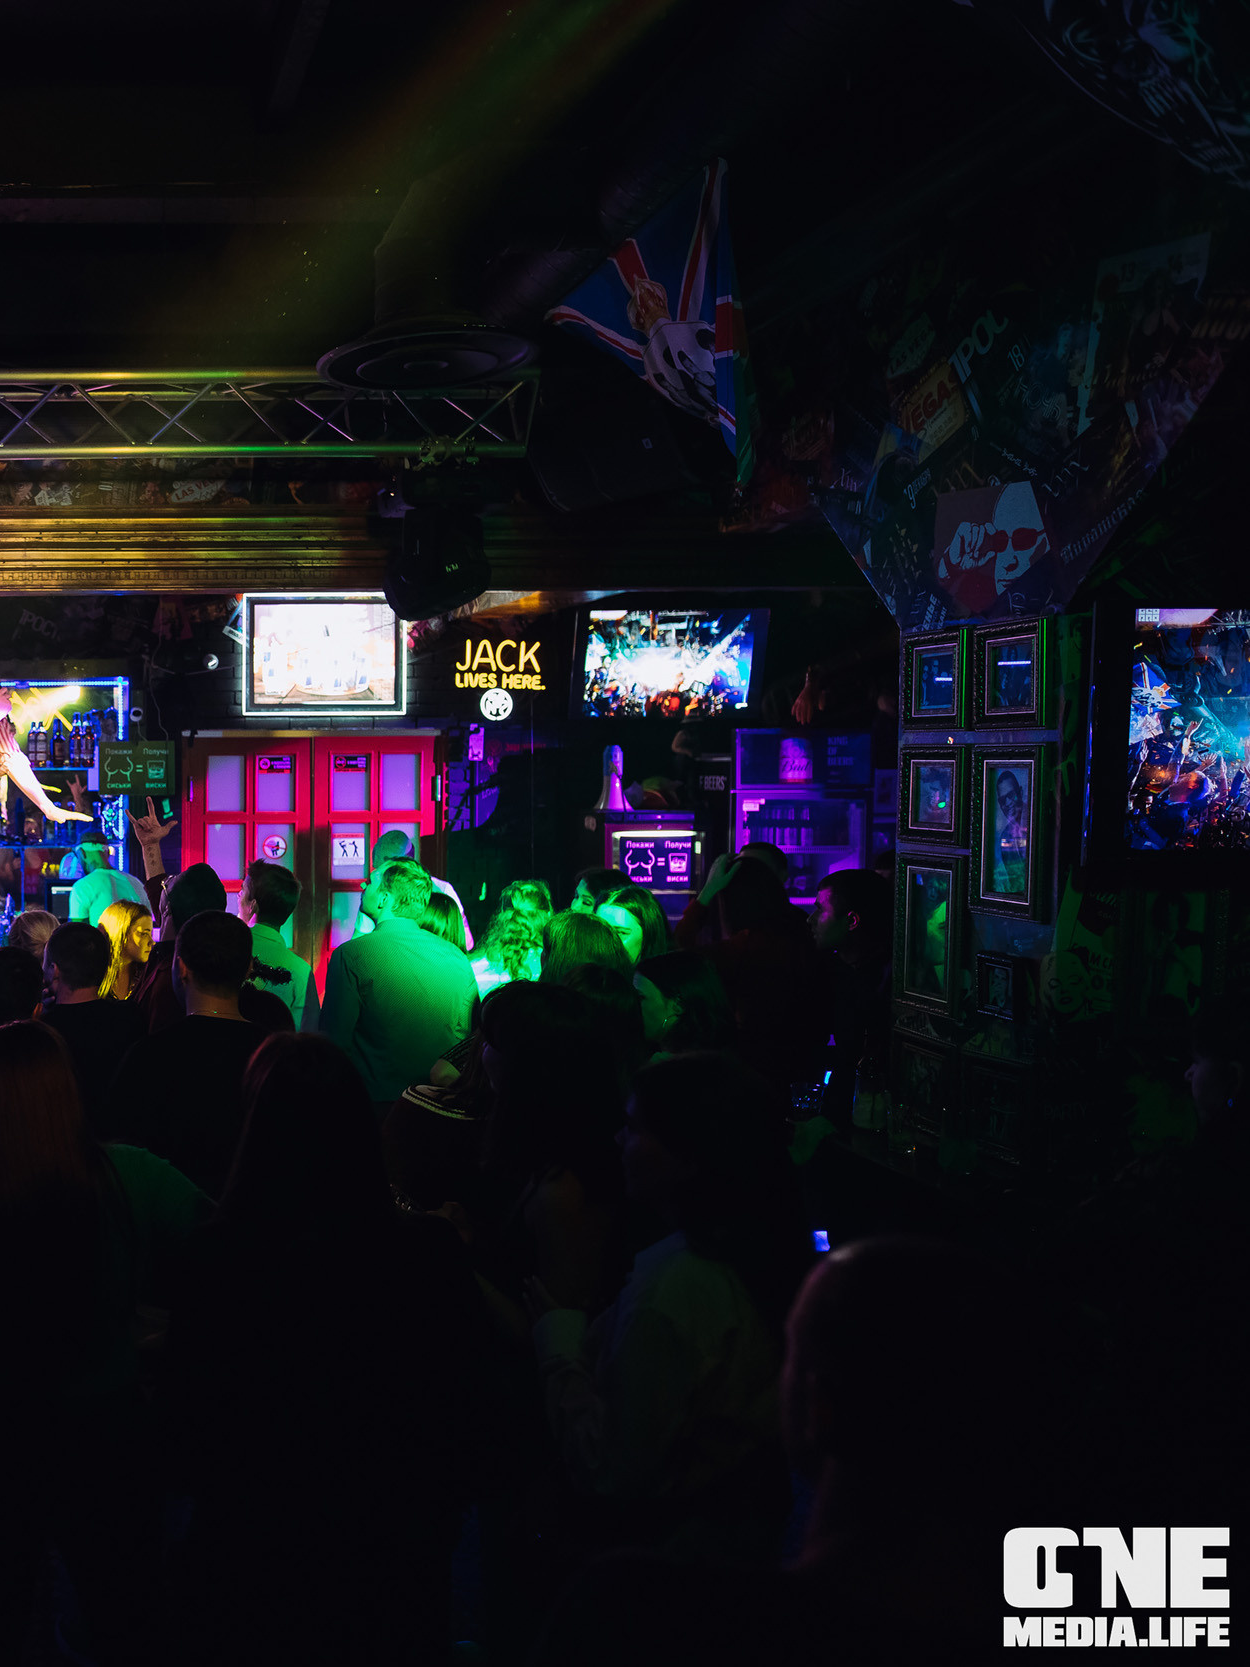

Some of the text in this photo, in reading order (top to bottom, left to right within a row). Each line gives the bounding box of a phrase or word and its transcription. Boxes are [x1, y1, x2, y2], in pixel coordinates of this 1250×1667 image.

[455, 638, 541, 673] JACK
[455, 672, 547, 690] LIVES HERE.
[105, 747, 169, 756] Покажи Получи
[625, 840, 692, 850] Покажи Получи
[630, 875, 689, 883] иськи виски
